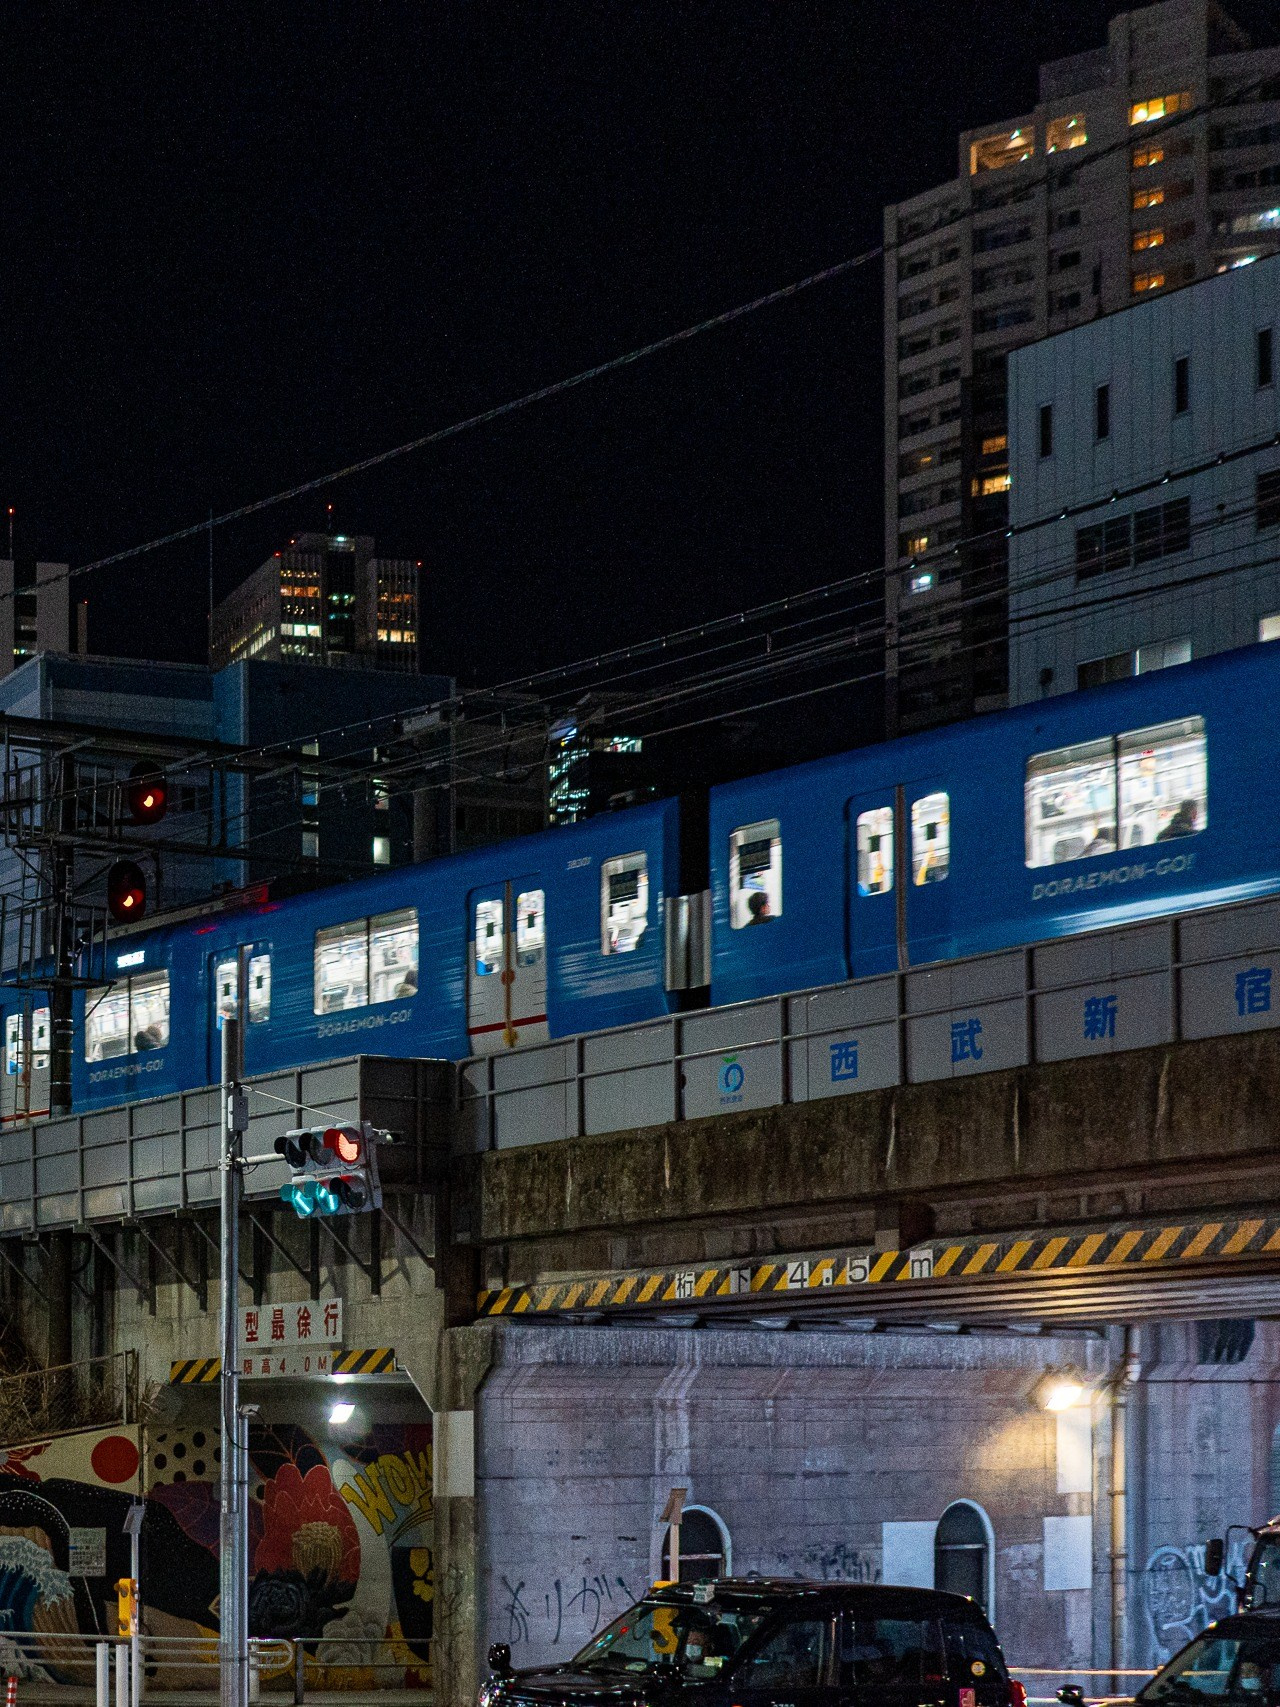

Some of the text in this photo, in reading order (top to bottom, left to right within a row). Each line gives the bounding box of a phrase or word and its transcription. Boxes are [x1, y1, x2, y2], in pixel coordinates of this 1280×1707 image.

[1031, 853, 1195, 900] DORAEMON-GO!
[317, 1009, 412, 1039] DORAEMON-GO!
[89, 1058, 164, 1084] DORAEMON-GO!
[245, 1303, 339, 1343] 型最徐行
[243, 1355, 327, 1375] 限高4.0M
